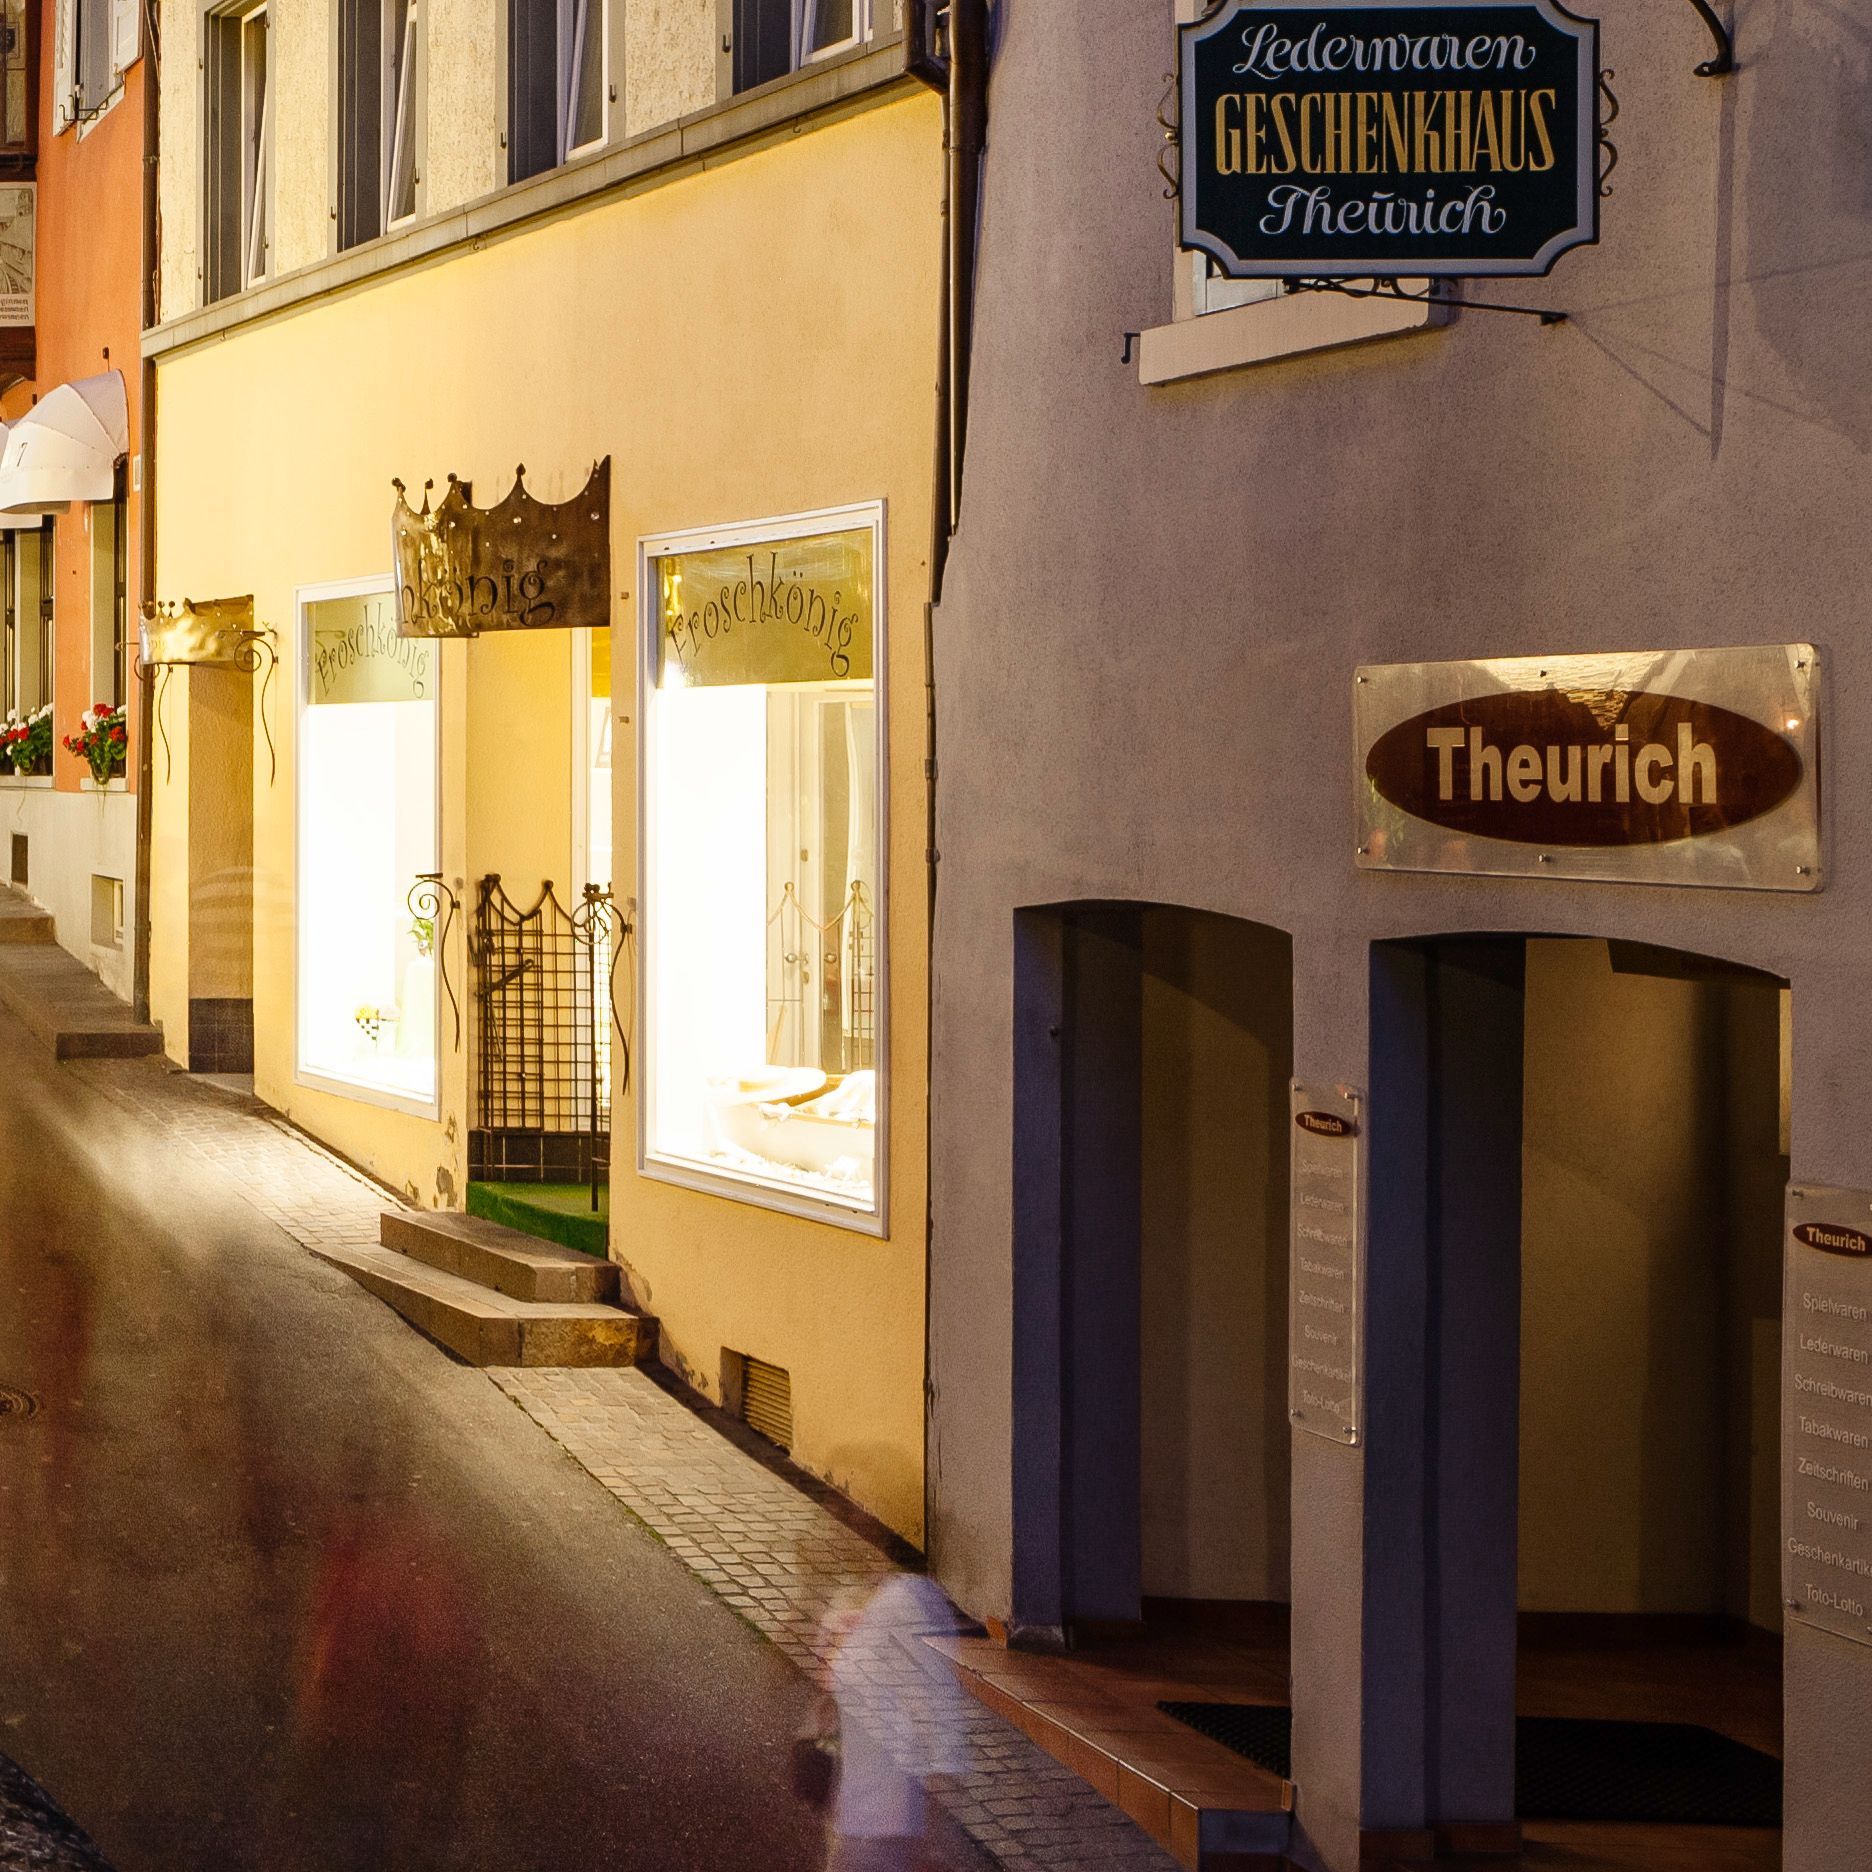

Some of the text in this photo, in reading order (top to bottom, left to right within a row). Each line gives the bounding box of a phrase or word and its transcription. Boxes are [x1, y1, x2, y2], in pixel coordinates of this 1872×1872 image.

[1232, 22, 1536, 80] Lederwaren
[1214, 87, 1557, 177] GESCHENKHAUS
[668, 551, 859, 677] Froschkönig
[1426, 722, 1718, 805] Theurich
[1304, 1114, 1343, 1133] Theurich
[1806, 1226, 1866, 1252] Theurich
[1803, 1292, 1867, 1321] Spielwaren
[1800, 1333, 1868, 1363] Lederwaren
[1794, 1374, 1872, 1407] Schreibwaren
[1800, 1415, 1869, 1449] Tabakwaren
[1797, 1457, 1869, 1492] Zeitschriften
[1807, 1501, 1859, 1530] Souvenir
[1806, 1583, 1864, 1617] Toto-Lotto
